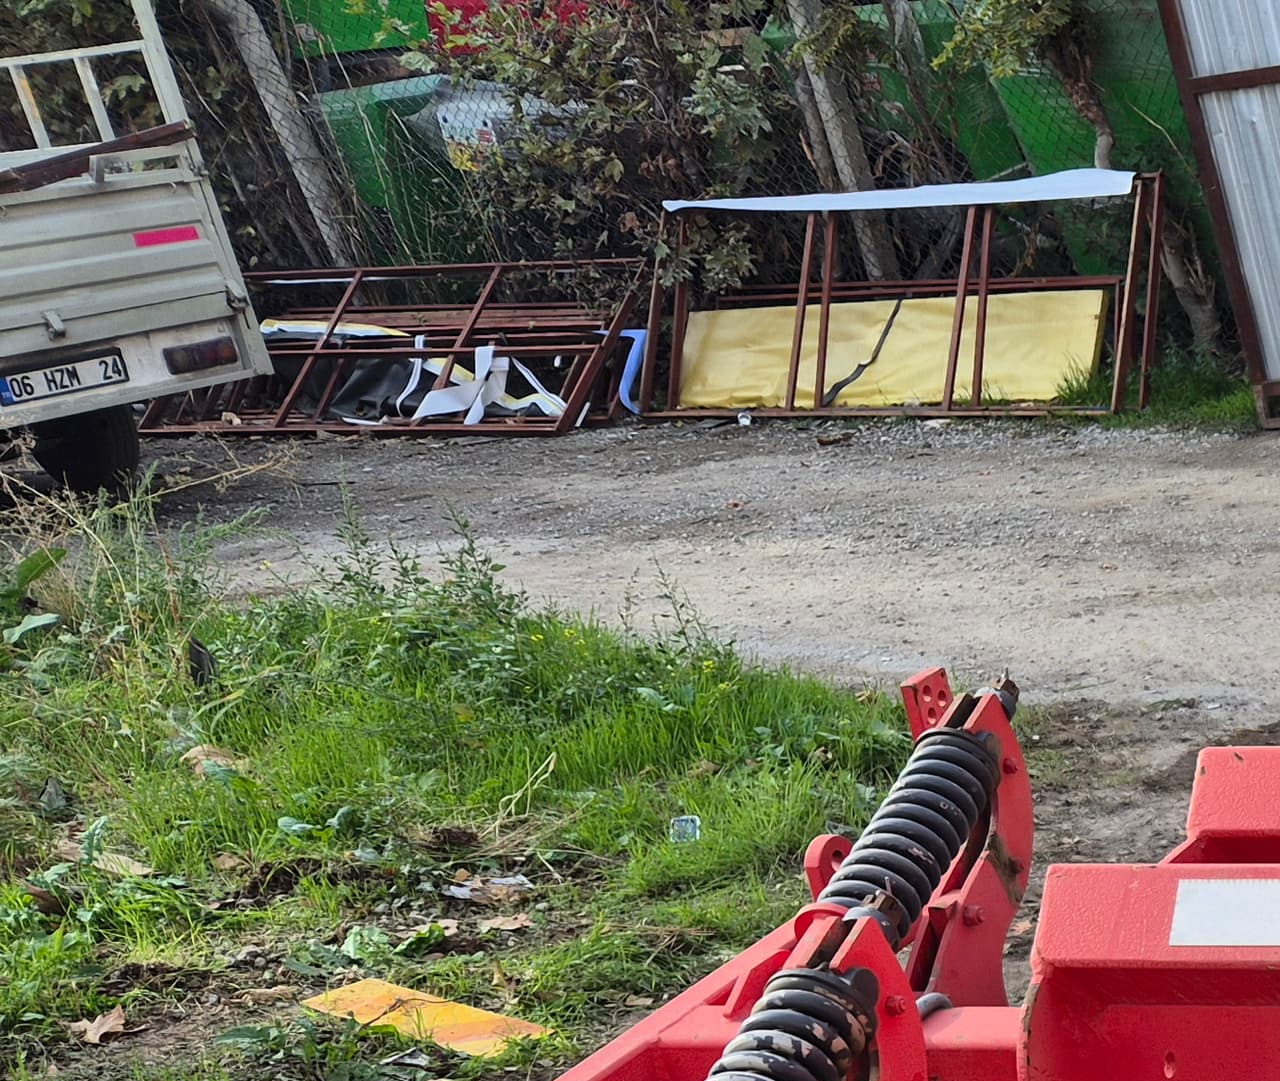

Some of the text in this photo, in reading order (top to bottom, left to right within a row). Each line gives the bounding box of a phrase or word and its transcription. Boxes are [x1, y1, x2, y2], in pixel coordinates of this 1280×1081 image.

[9, 357, 122, 398] 06 HZM 24
